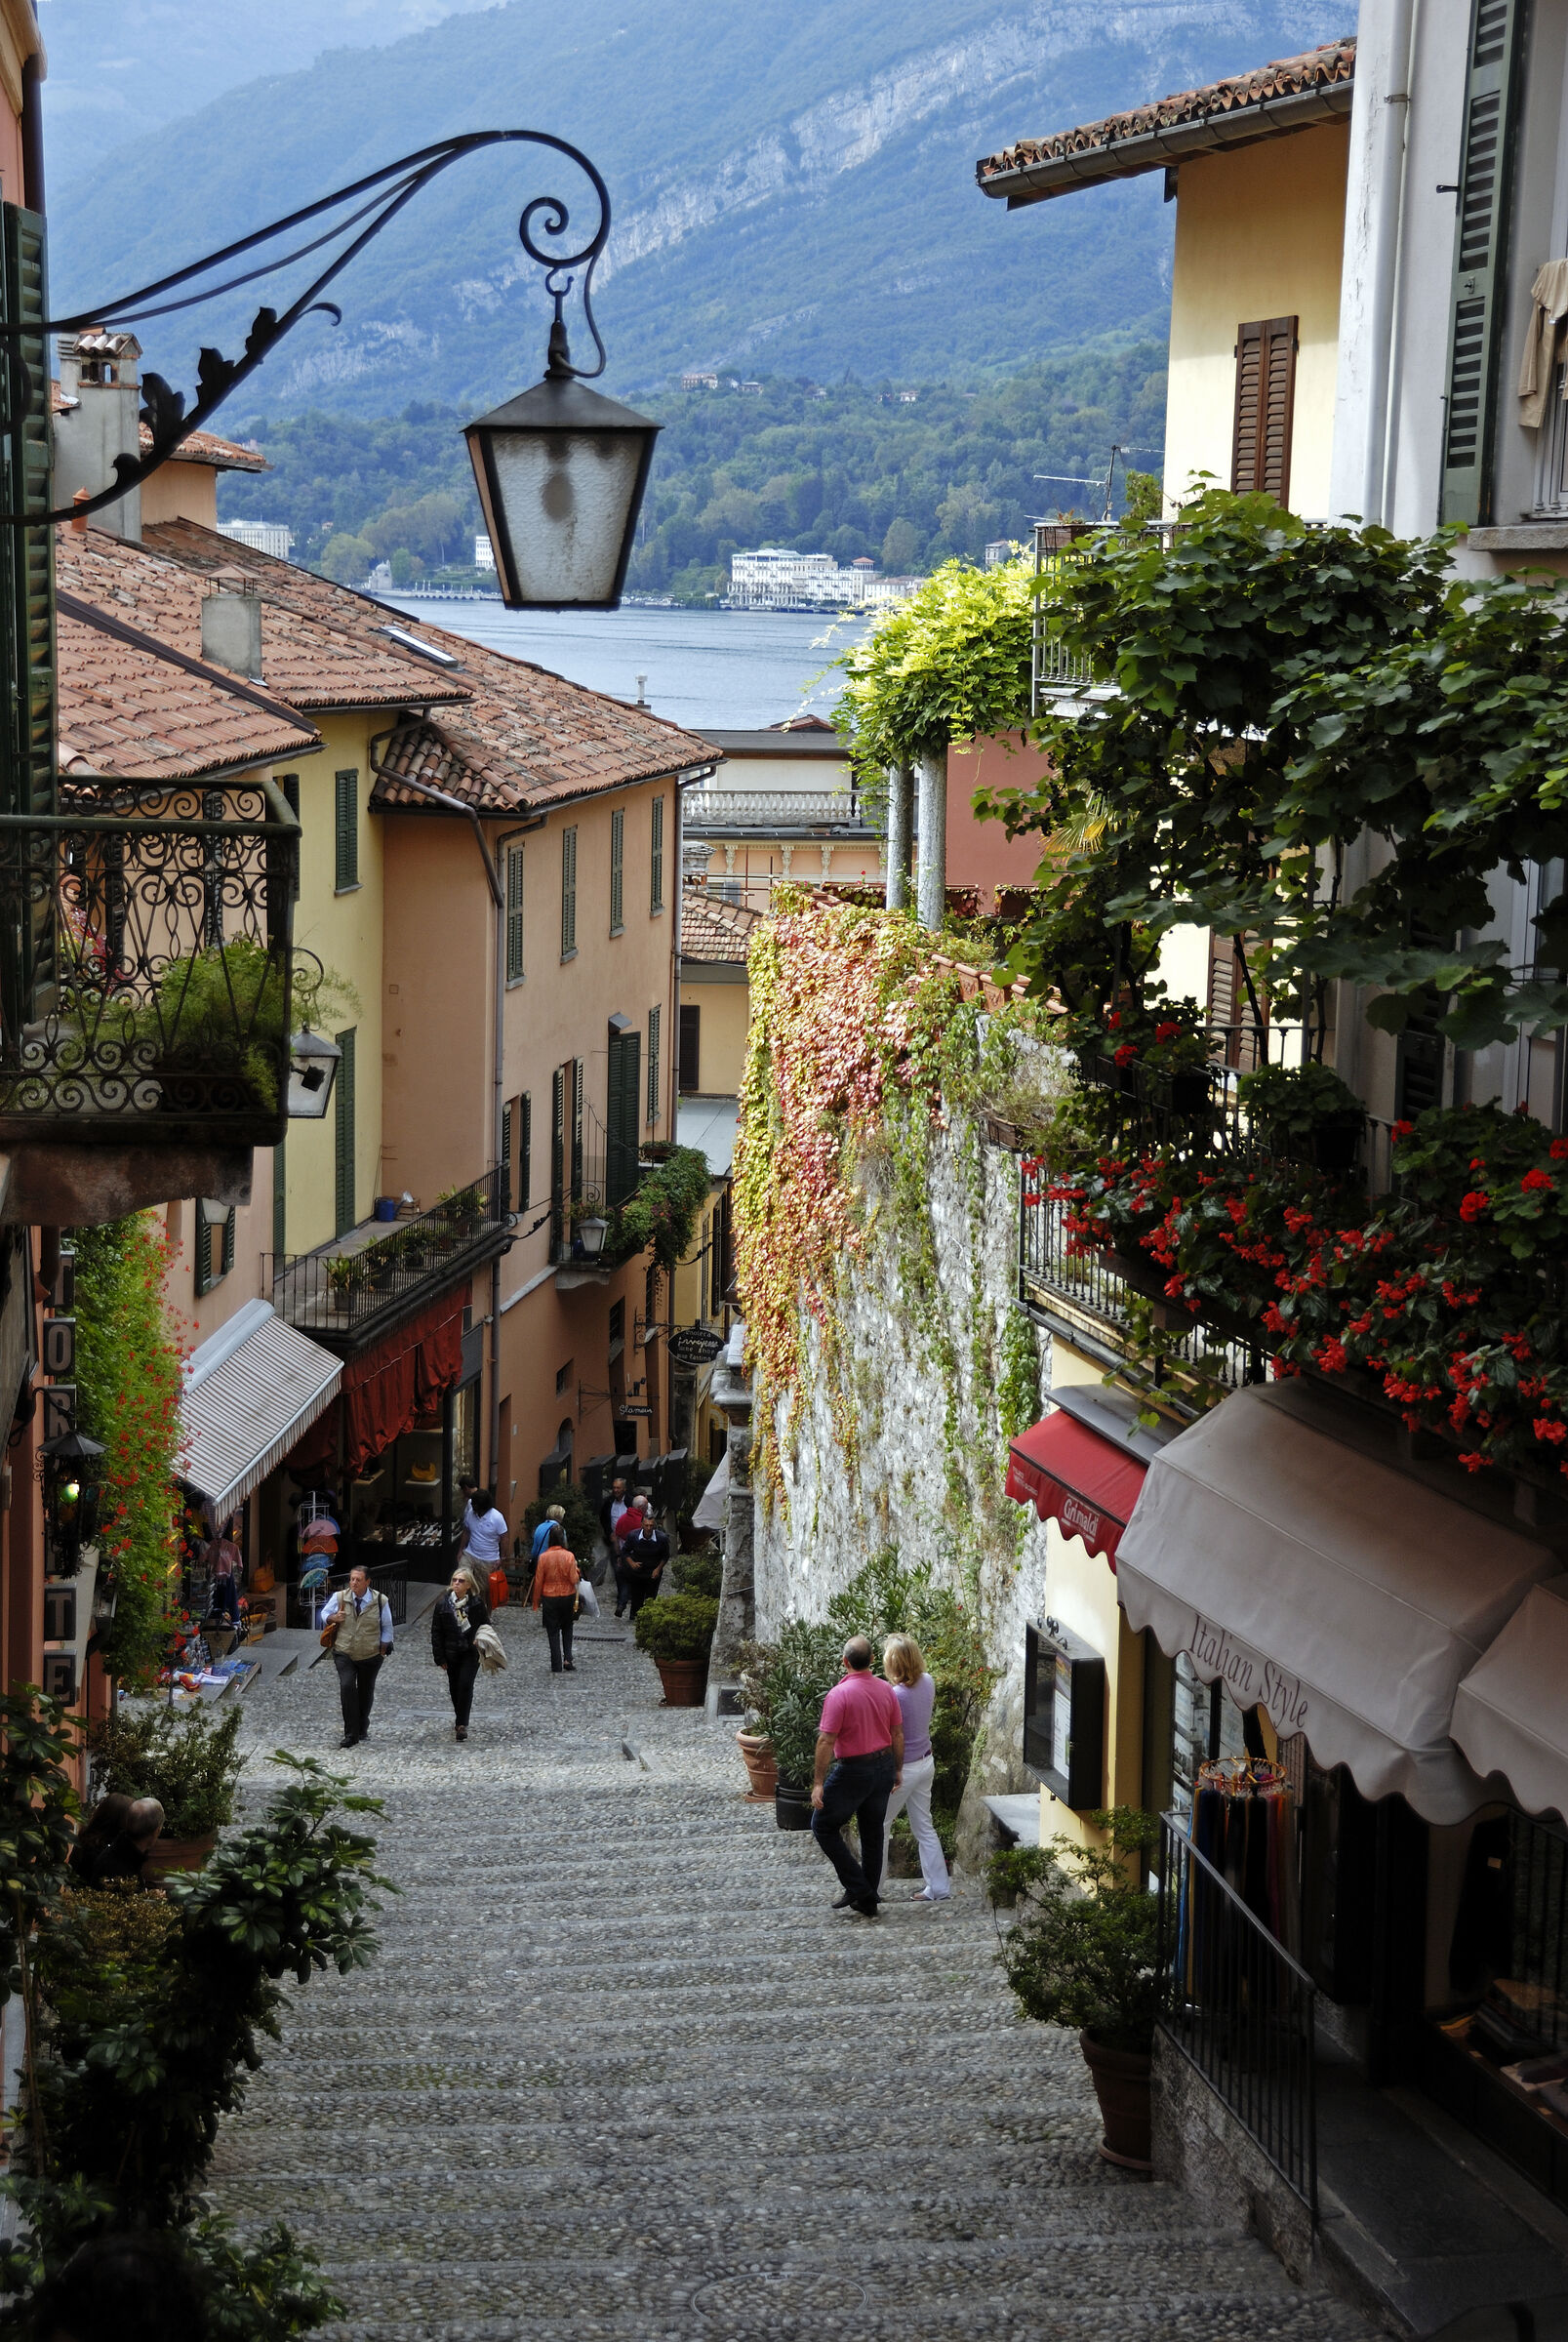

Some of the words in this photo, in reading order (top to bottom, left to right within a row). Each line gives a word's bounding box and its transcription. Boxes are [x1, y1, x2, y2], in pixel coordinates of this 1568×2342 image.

[1064, 1498, 1100, 1538] Grimaldi
[1188, 1613, 1253, 1692] Italian
[1258, 1660, 1308, 1729] Style
